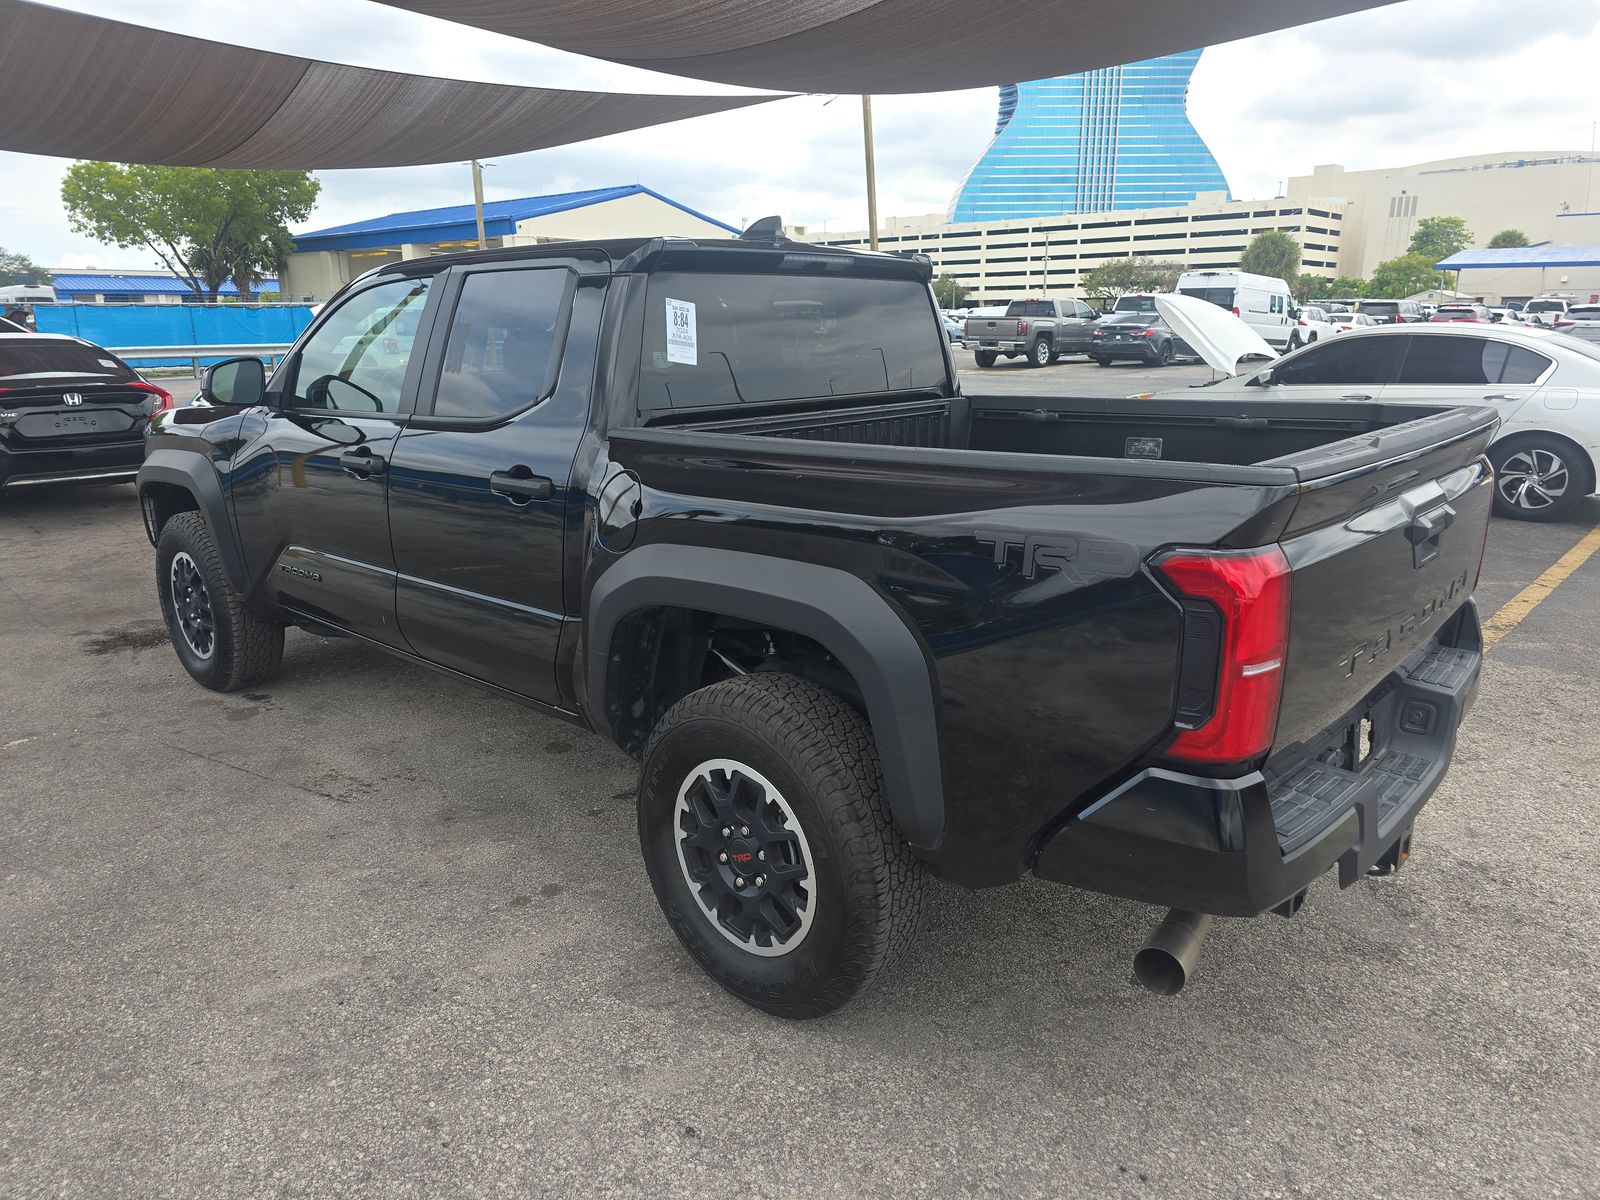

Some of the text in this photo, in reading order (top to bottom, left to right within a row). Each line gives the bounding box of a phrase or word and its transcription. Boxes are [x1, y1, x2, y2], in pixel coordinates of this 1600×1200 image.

[673, 310, 688, 328] 8:84
[974, 529, 1140, 586] TRD
[279, 562, 323, 582] TACOMA
[1338, 568, 1468, 680] TACOMA
[731, 853, 752, 862] TRD
